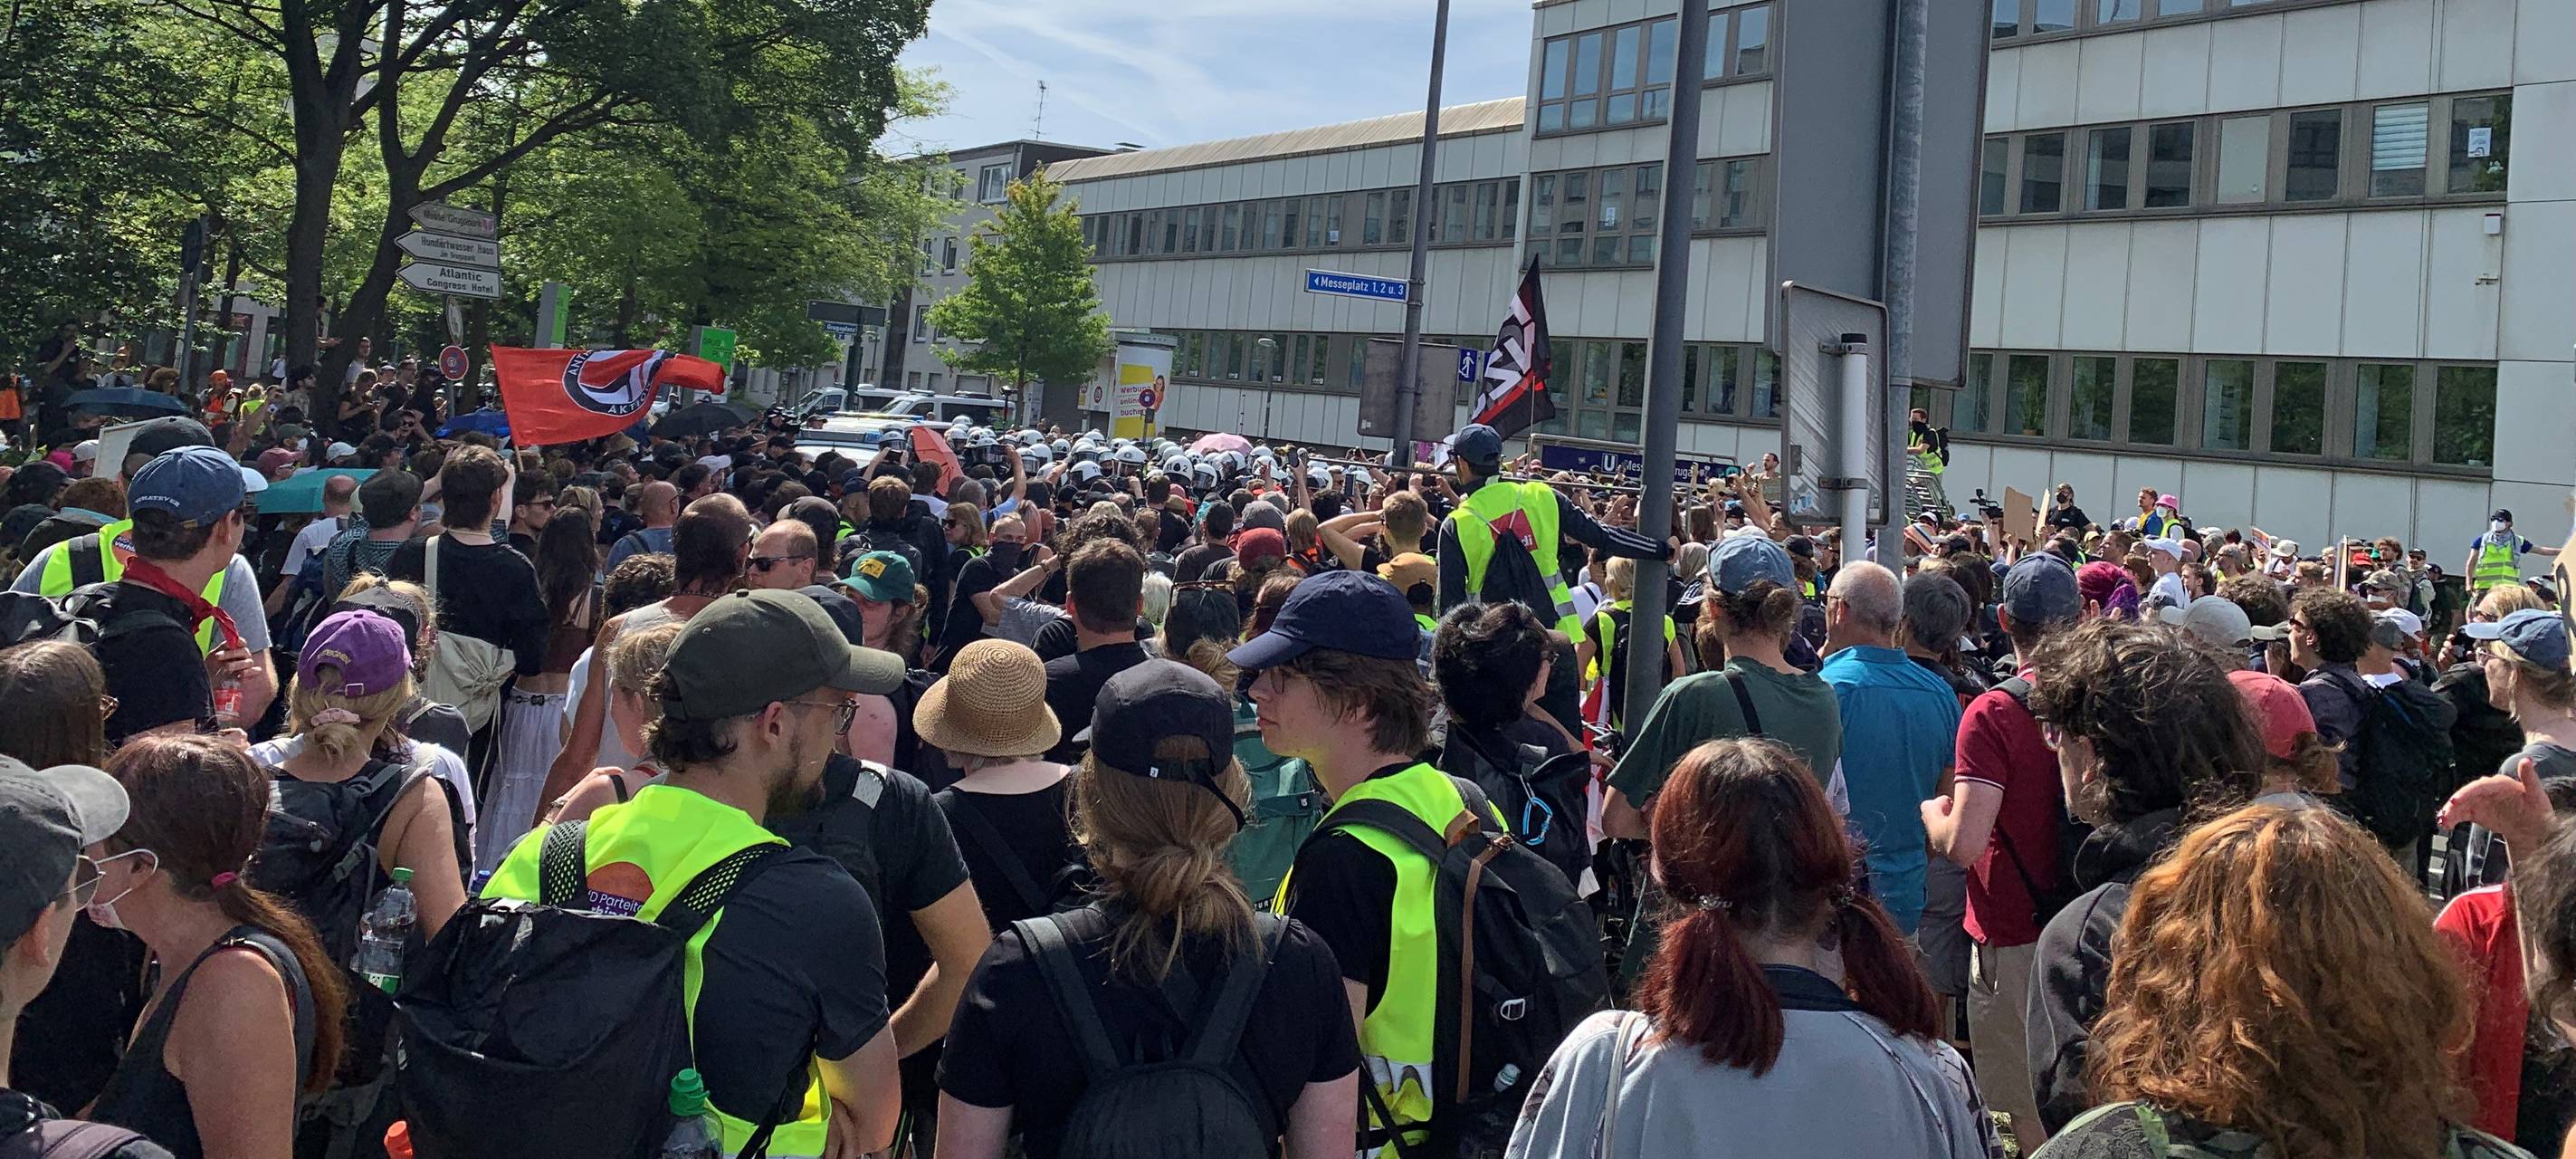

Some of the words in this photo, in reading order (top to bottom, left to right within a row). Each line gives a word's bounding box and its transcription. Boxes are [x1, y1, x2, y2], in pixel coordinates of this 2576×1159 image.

[421, 235, 474, 253] Hundertwasser
[477, 244, 495, 255] Haus
[439, 267, 482, 282] Atlantic
[426, 277, 467, 291] Congress
[472, 283, 494, 293] Hotel
[1321, 275, 1369, 292] Messeplatz
[1380, 283, 1387, 294] 2
[1388, 287, 1397, 295] u.
[1398, 284, 1405, 296] 3
[1604, 455, 1615, 471] U
[135, 495, 181, 508] WHATEVER
